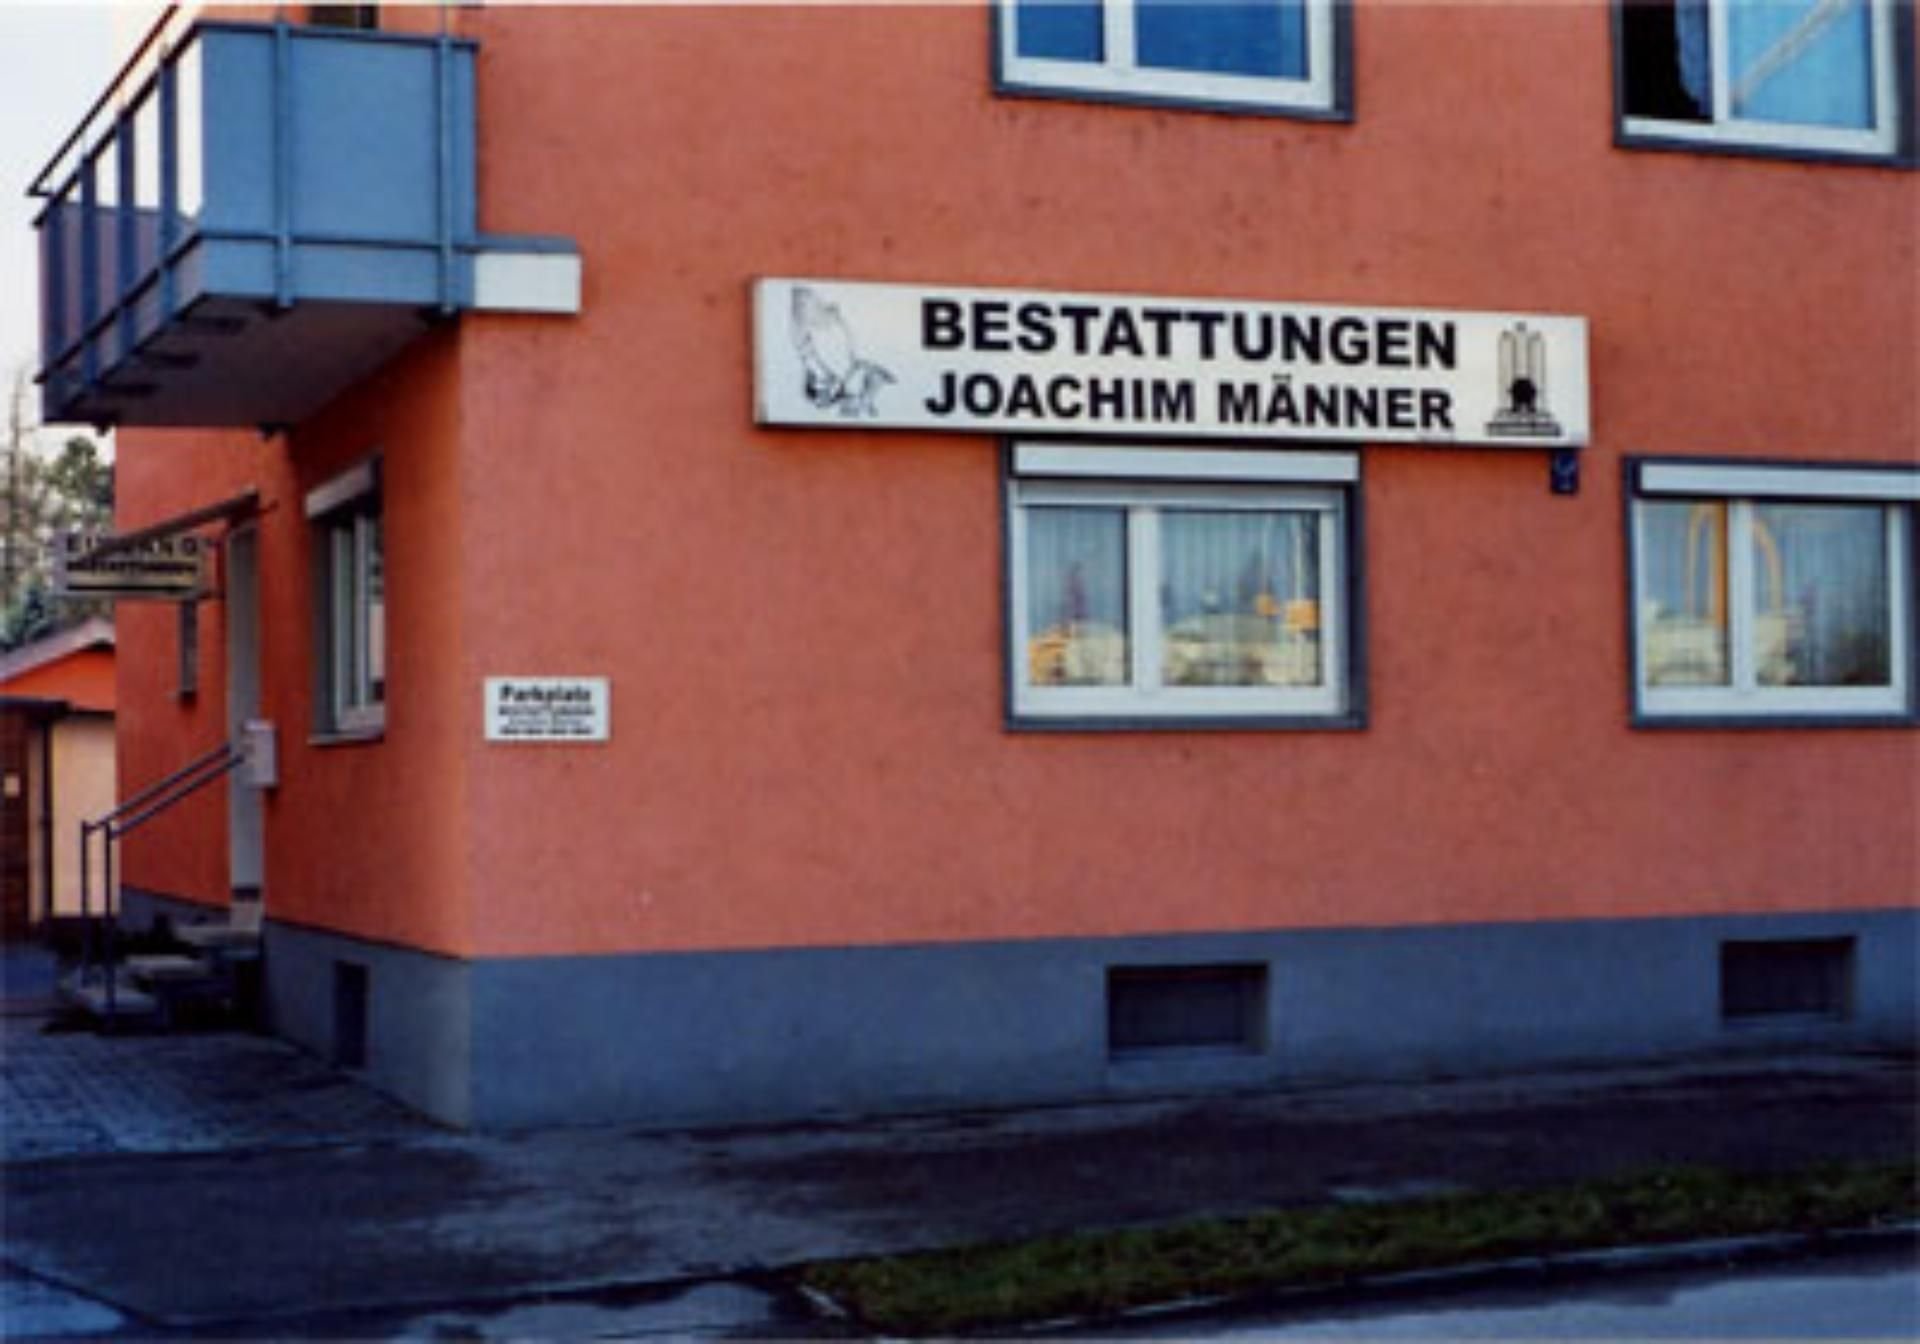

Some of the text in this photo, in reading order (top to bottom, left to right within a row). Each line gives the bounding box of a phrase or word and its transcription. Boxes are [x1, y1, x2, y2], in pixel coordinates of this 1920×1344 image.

[921, 299, 1456, 370] BESTATTUNGEN
[925, 371, 1454, 430] JOACHIM MÄNNER
